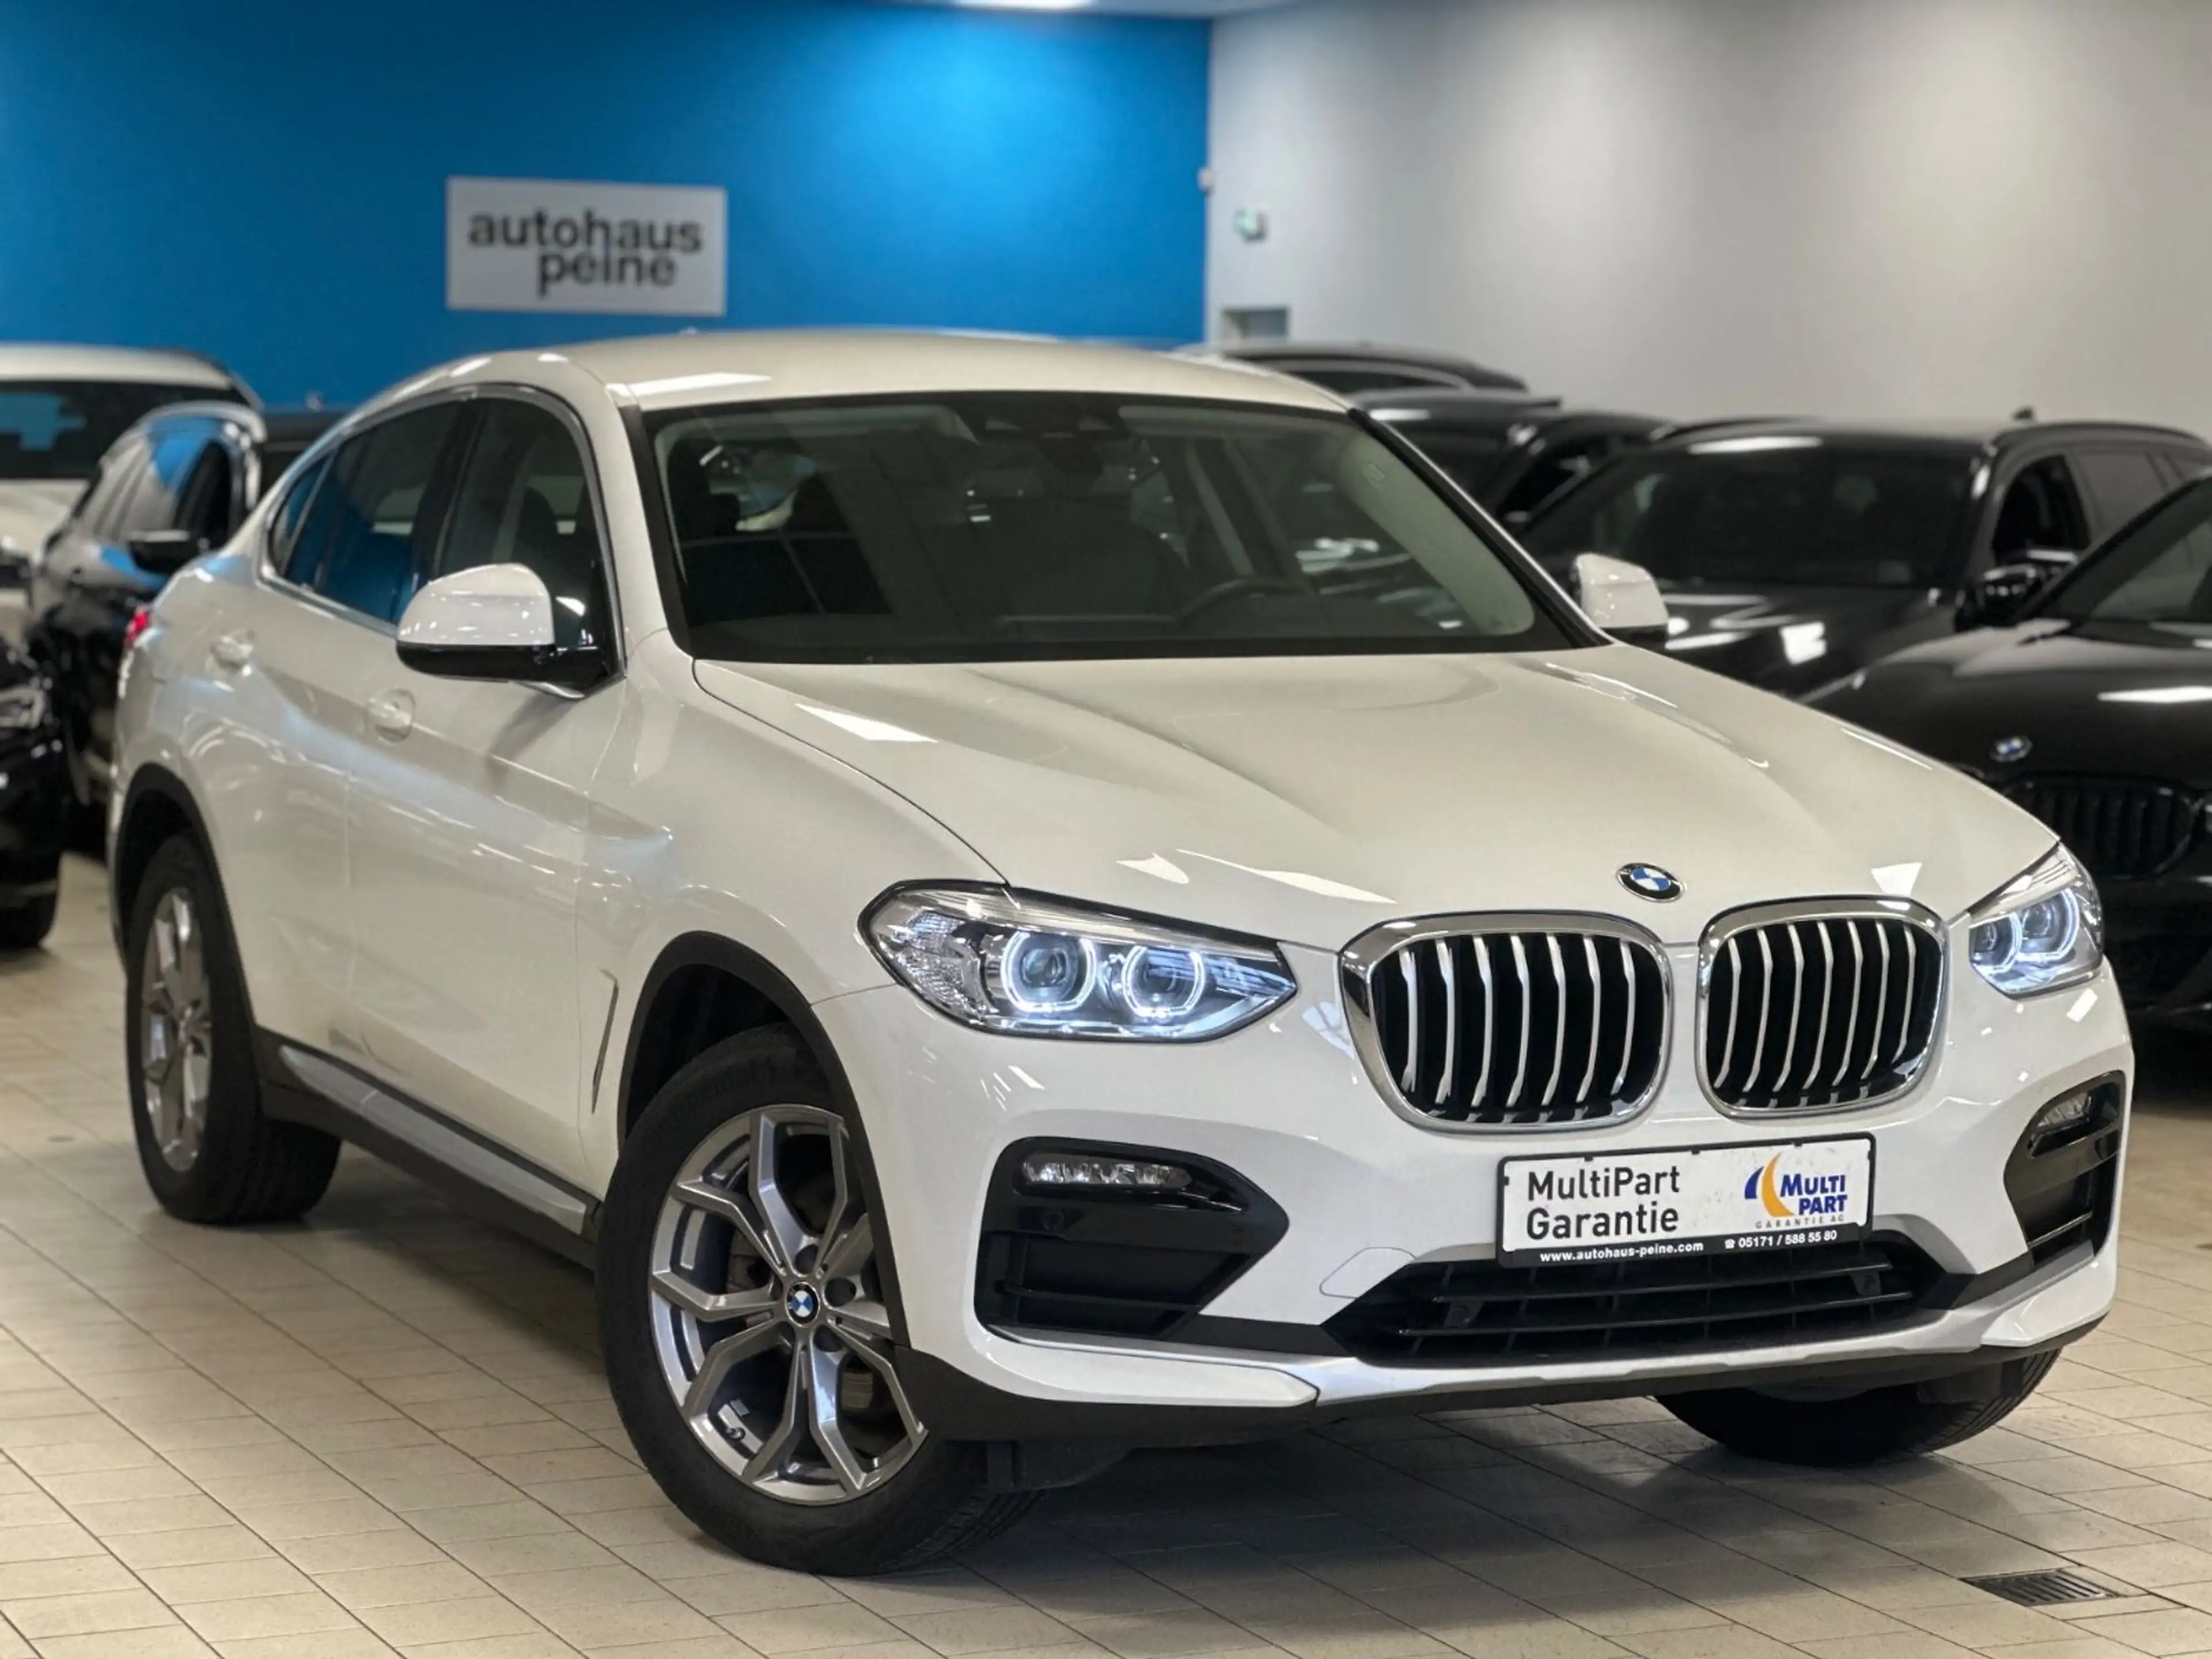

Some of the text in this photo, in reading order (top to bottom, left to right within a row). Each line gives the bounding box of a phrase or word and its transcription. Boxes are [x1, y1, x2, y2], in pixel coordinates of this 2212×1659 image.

[467, 206, 702, 252] autohaus
[538, 252, 676, 298] peine
[1528, 1166, 1680, 1201] MultiPart
[1780, 1173, 1846, 1197] MULTI
[1798, 1194, 1847, 1215] PART
[1527, 1201, 1679, 1240] Garantie
[1755, 1216, 1824, 1228] GARANTIE
[1738, 1236, 1774, 1248] 05171
[1808, 1231, 1821, 1243] 55
[1824, 1229, 1838, 1241] 80
[1540, 1241, 1704, 1262] www.autohaus-peine.com
